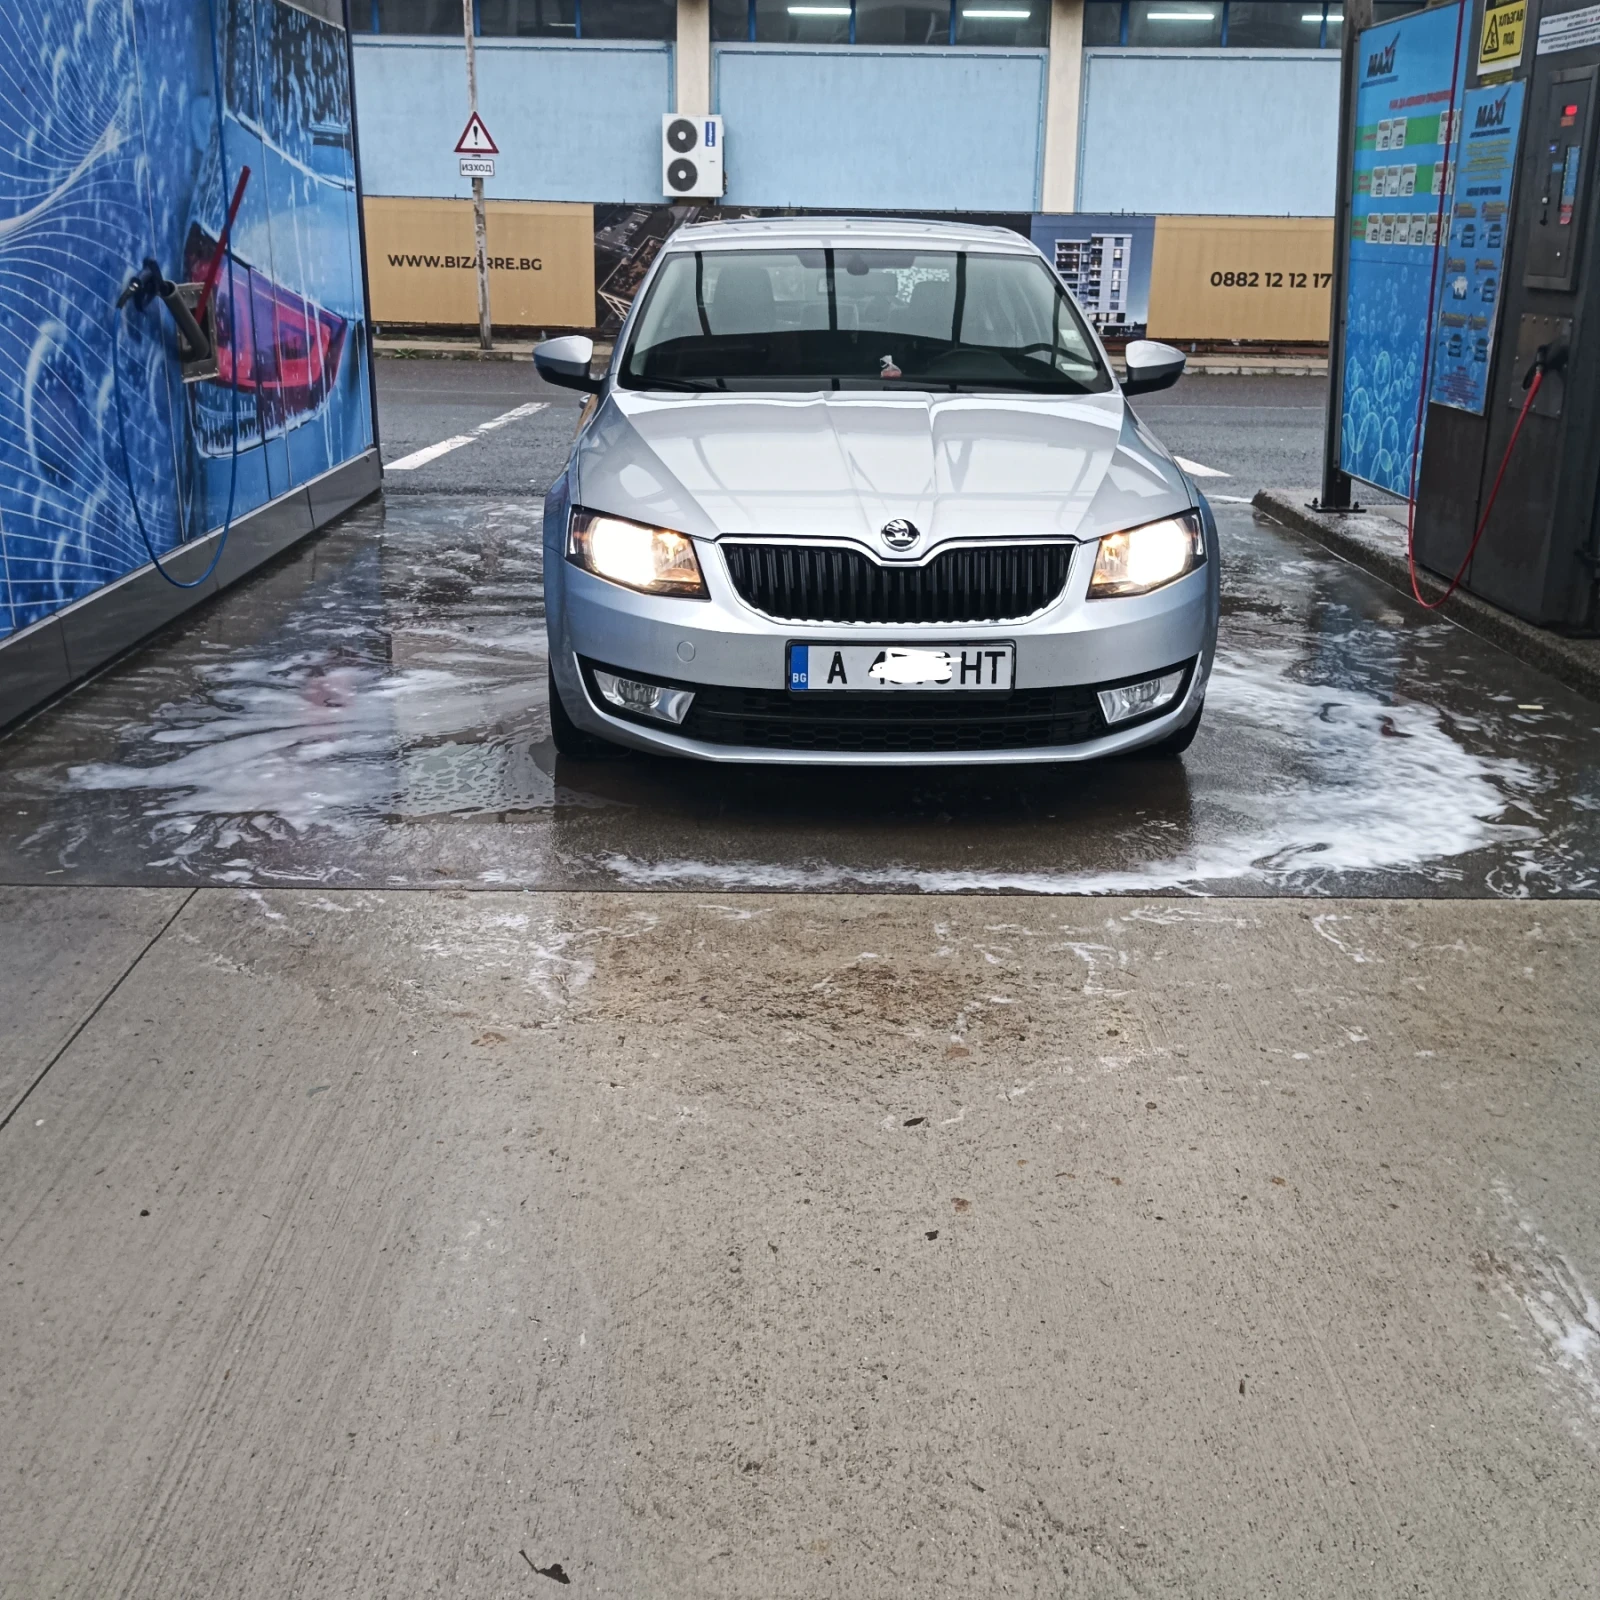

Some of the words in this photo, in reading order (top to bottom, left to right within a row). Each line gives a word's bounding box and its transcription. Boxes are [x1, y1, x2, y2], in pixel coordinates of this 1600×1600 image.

[1475, 92, 1509, 129] MAXI
[461, 163, 493, 173] ИЗХОД
[1210, 271, 1259, 287] 0882
[1264, 272, 1283, 288] 12
[1288, 272, 1307, 288] 12
[1312, 273, 1332, 288] 17
[792, 673, 807, 683] BG
